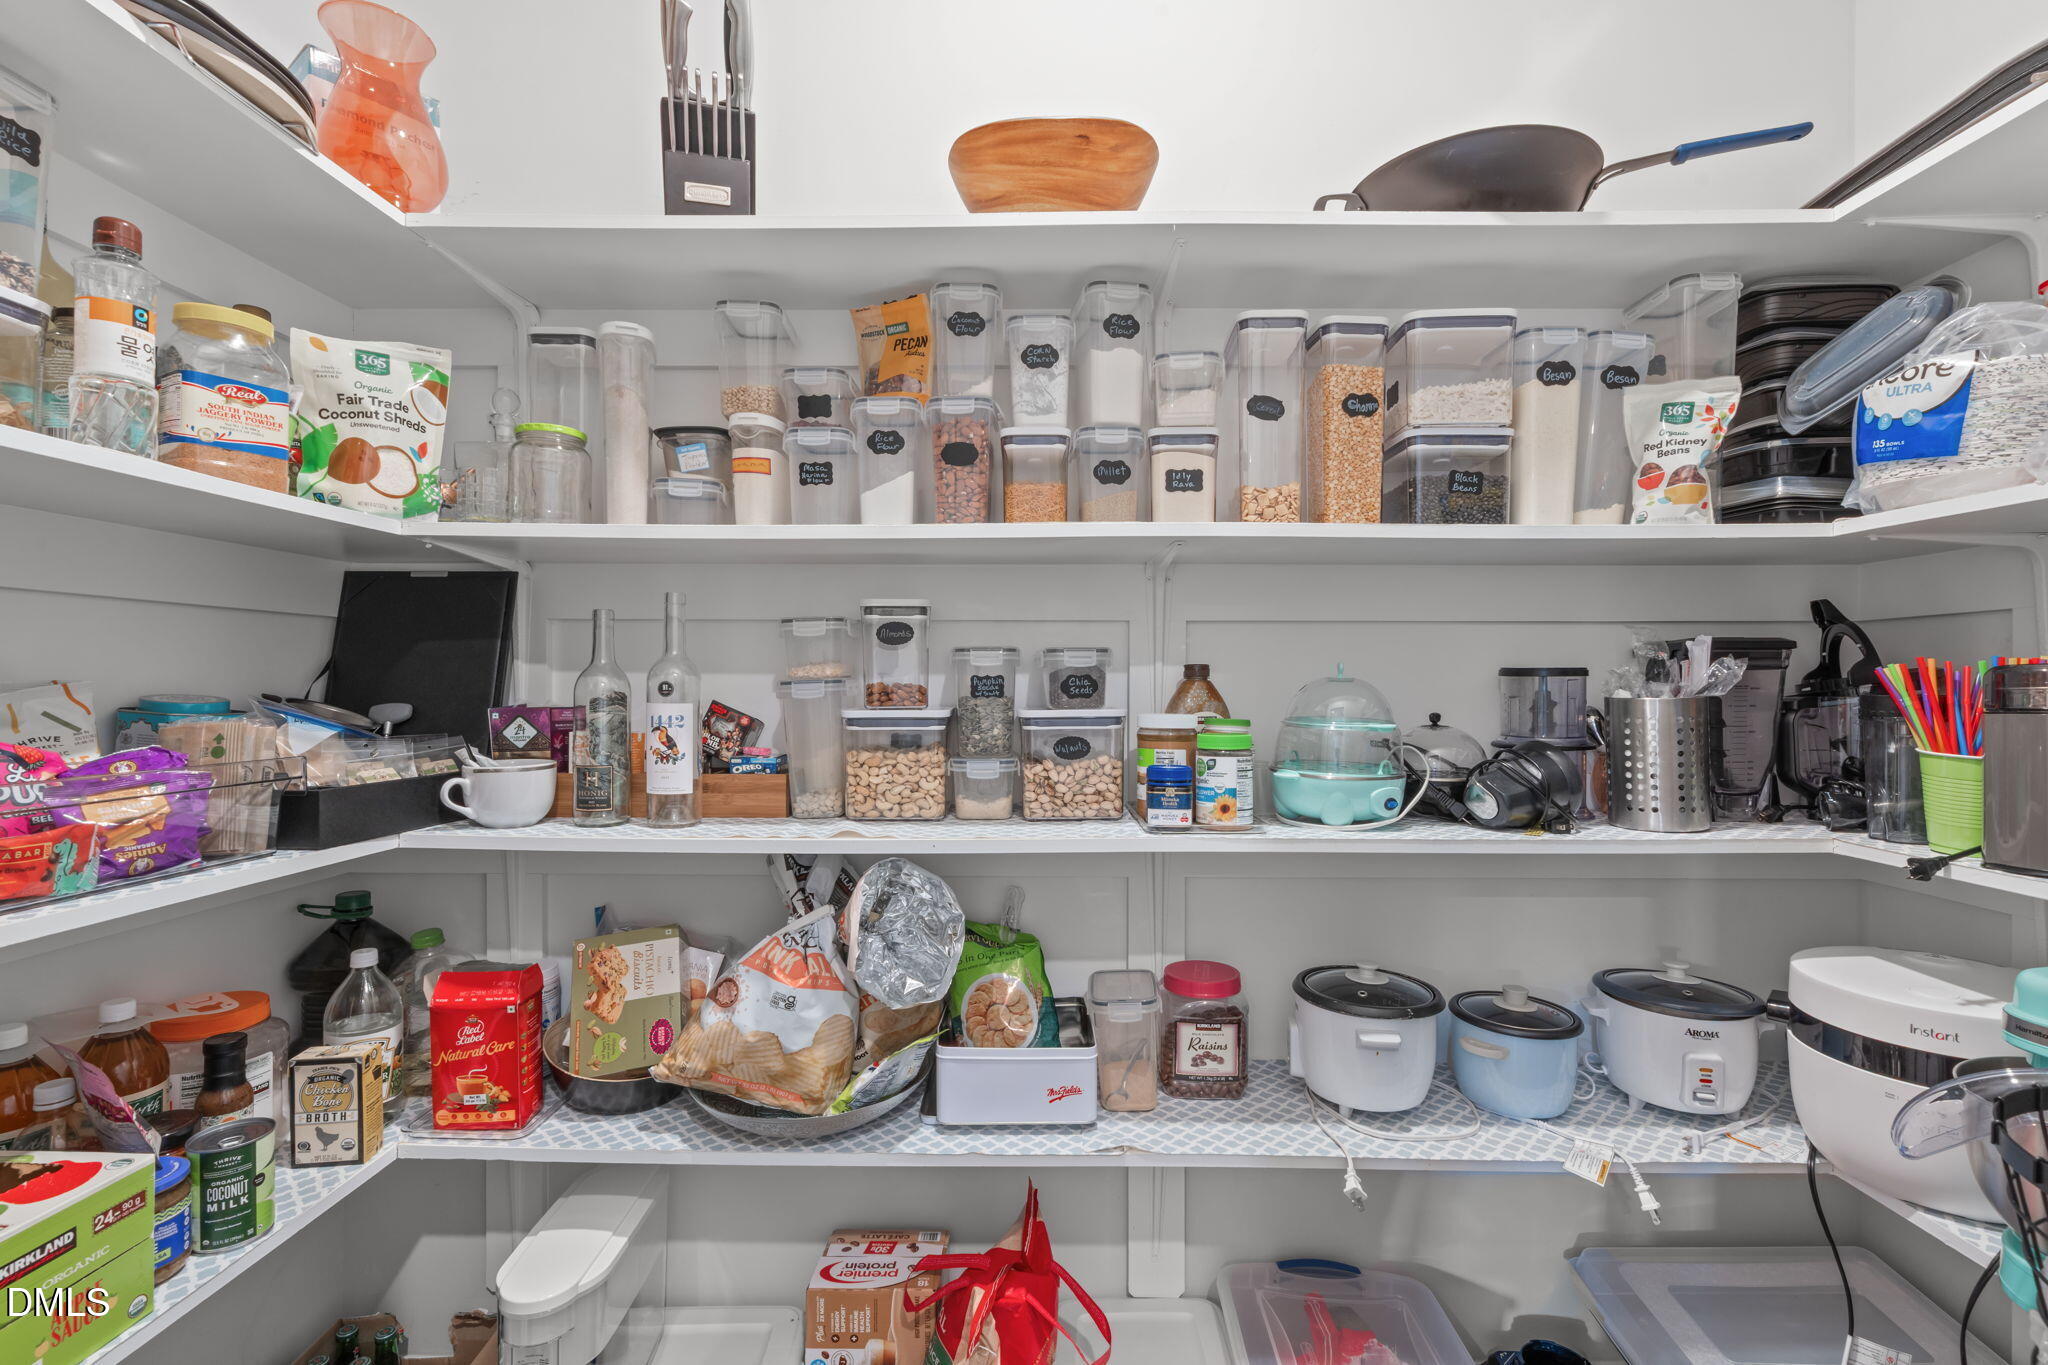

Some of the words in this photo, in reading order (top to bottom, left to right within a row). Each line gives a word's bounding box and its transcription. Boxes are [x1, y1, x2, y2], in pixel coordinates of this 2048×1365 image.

[861, 330, 884, 338] WOODSTOCK
[888, 324, 907, 334] ORGANIC
[956, 325, 981, 334] Flour
[1109, 326, 1135, 336] Flour
[893, 337, 928, 352] PECAN
[359, 355, 387, 368] 365
[1543, 368, 1572, 381] Besan
[1606, 370, 1637, 385] Besan
[221, 384, 264, 401] Real
[354, 381, 393, 394] Organic
[1886, 382, 1932, 398] ULTRA
[337, 393, 364, 405] Fair
[368, 396, 409, 414] Trade
[208, 402, 240, 413] SOUTH
[243, 409, 275, 421] INDIAN
[1663, 405, 1690, 417] 365
[198, 406, 241, 420] JAGGERY
[245, 416, 283, 430] POWDER
[318, 408, 380, 420] Coconut
[384, 411, 427, 434] Shreds
[350, 421, 400, 433] Unsweetened
[875, 433, 894, 442] Rice
[1643, 441, 1663, 453] Red
[1665, 438, 1708, 450] Kidney
[1657, 448, 1690, 458] Beans
[1455, 473, 1478, 484] Black
[1453, 483, 1478, 492] Beans
[1069, 678, 1091, 686] Chia
[1070, 686, 1093, 694] Seeds
[650, 715, 684, 729] 1442
[514, 726, 526, 736] 24
[17, 735, 62, 748] HRIVE
[733, 764, 762, 773] OREO
[124, 843, 157, 852] ORGANIC
[632, 950, 644, 991] Biscuits
[644, 943, 655, 996] PISTACHIO
[458, 1020, 484, 1038] Red
[1684, 1028, 1719, 1039] AROMA
[1910, 1024, 1960, 1043] Instant
[456, 1033, 485, 1046] Label
[1187, 1037, 1228, 1051] Raisins
[433, 1046, 485, 1067] Natural
[485, 1040, 515, 1056] Care
[314, 1075, 341, 1083] ORGANIC
[304, 1083, 349, 1096] Chicken
[312, 1094, 341, 1108] Bone
[306, 1111, 347, 1123] BROTH
[213, 1154, 243, 1165] THRIVE
[211, 1175, 245, 1187] ORGANIC
[206, 1179, 249, 1198] COCONUT
[122, 1200, 133, 1212] 90
[135, 1197, 141, 1209] g
[206, 1195, 249, 1212] MILK
[0, 1230, 75, 1280] KIRKLAND
[41, 1245, 111, 1291] ORGANIC
[845, 1260, 897, 1271] protein
[837, 1269, 899, 1279] premier
[816, 1325, 826, 1343] Plus
